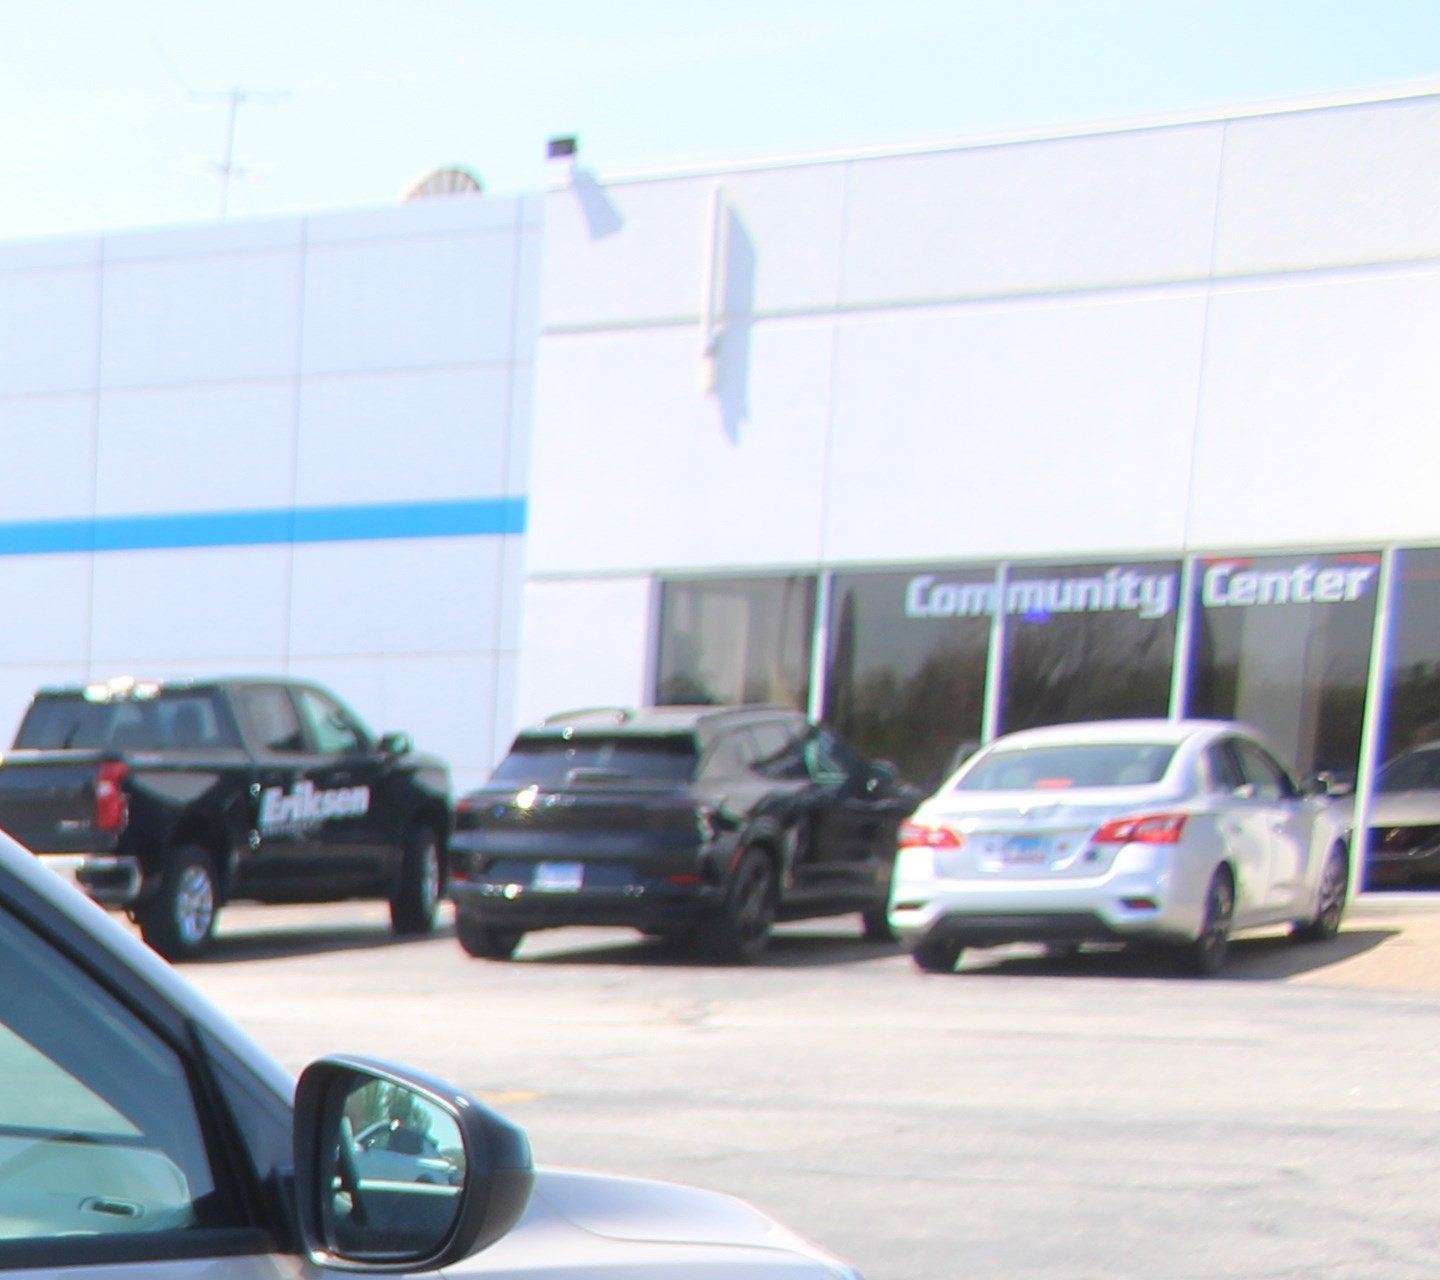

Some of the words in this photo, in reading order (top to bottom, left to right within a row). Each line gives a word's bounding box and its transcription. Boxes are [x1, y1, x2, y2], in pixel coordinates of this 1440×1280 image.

[904, 566, 1177, 620] Community
[1202, 560, 1377, 608] Center
[260, 779, 371, 827] Eriksen
